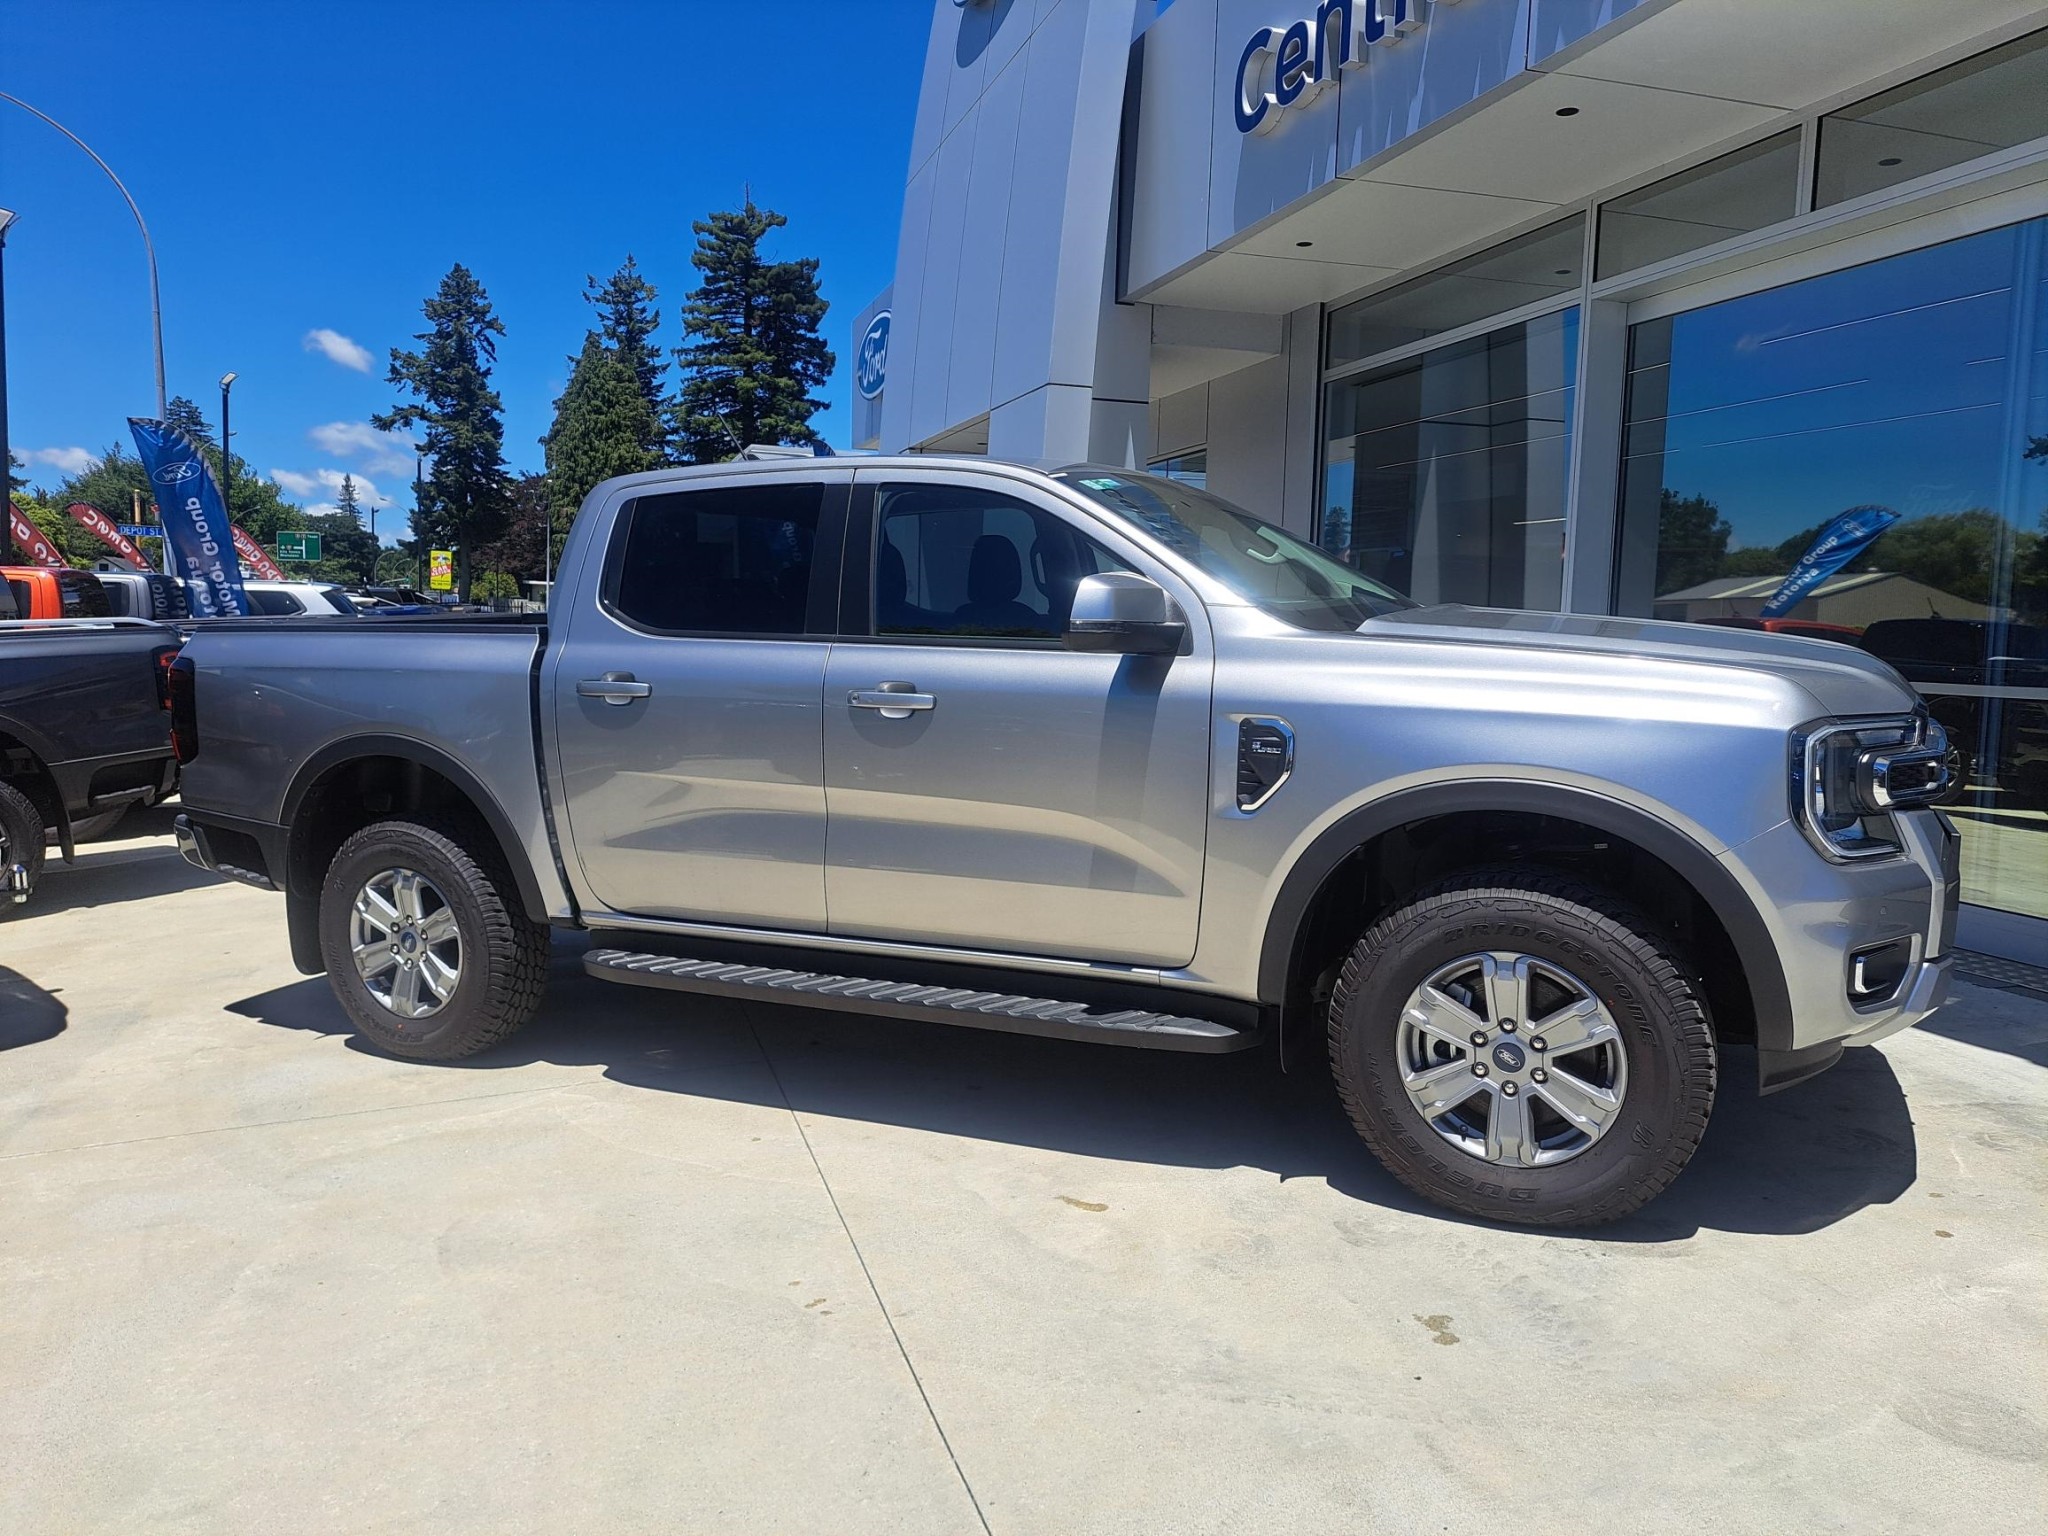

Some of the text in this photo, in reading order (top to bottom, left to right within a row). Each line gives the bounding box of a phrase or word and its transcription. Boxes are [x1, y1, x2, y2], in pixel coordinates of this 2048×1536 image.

[862, 327, 888, 388] Ford
[120, 525, 160, 536] DEPOT ST
[1802, 535, 1839, 565] Group
[1767, 567, 1820, 609] Rotorua
[1443, 921, 1657, 1048] BRIDGESTONE
